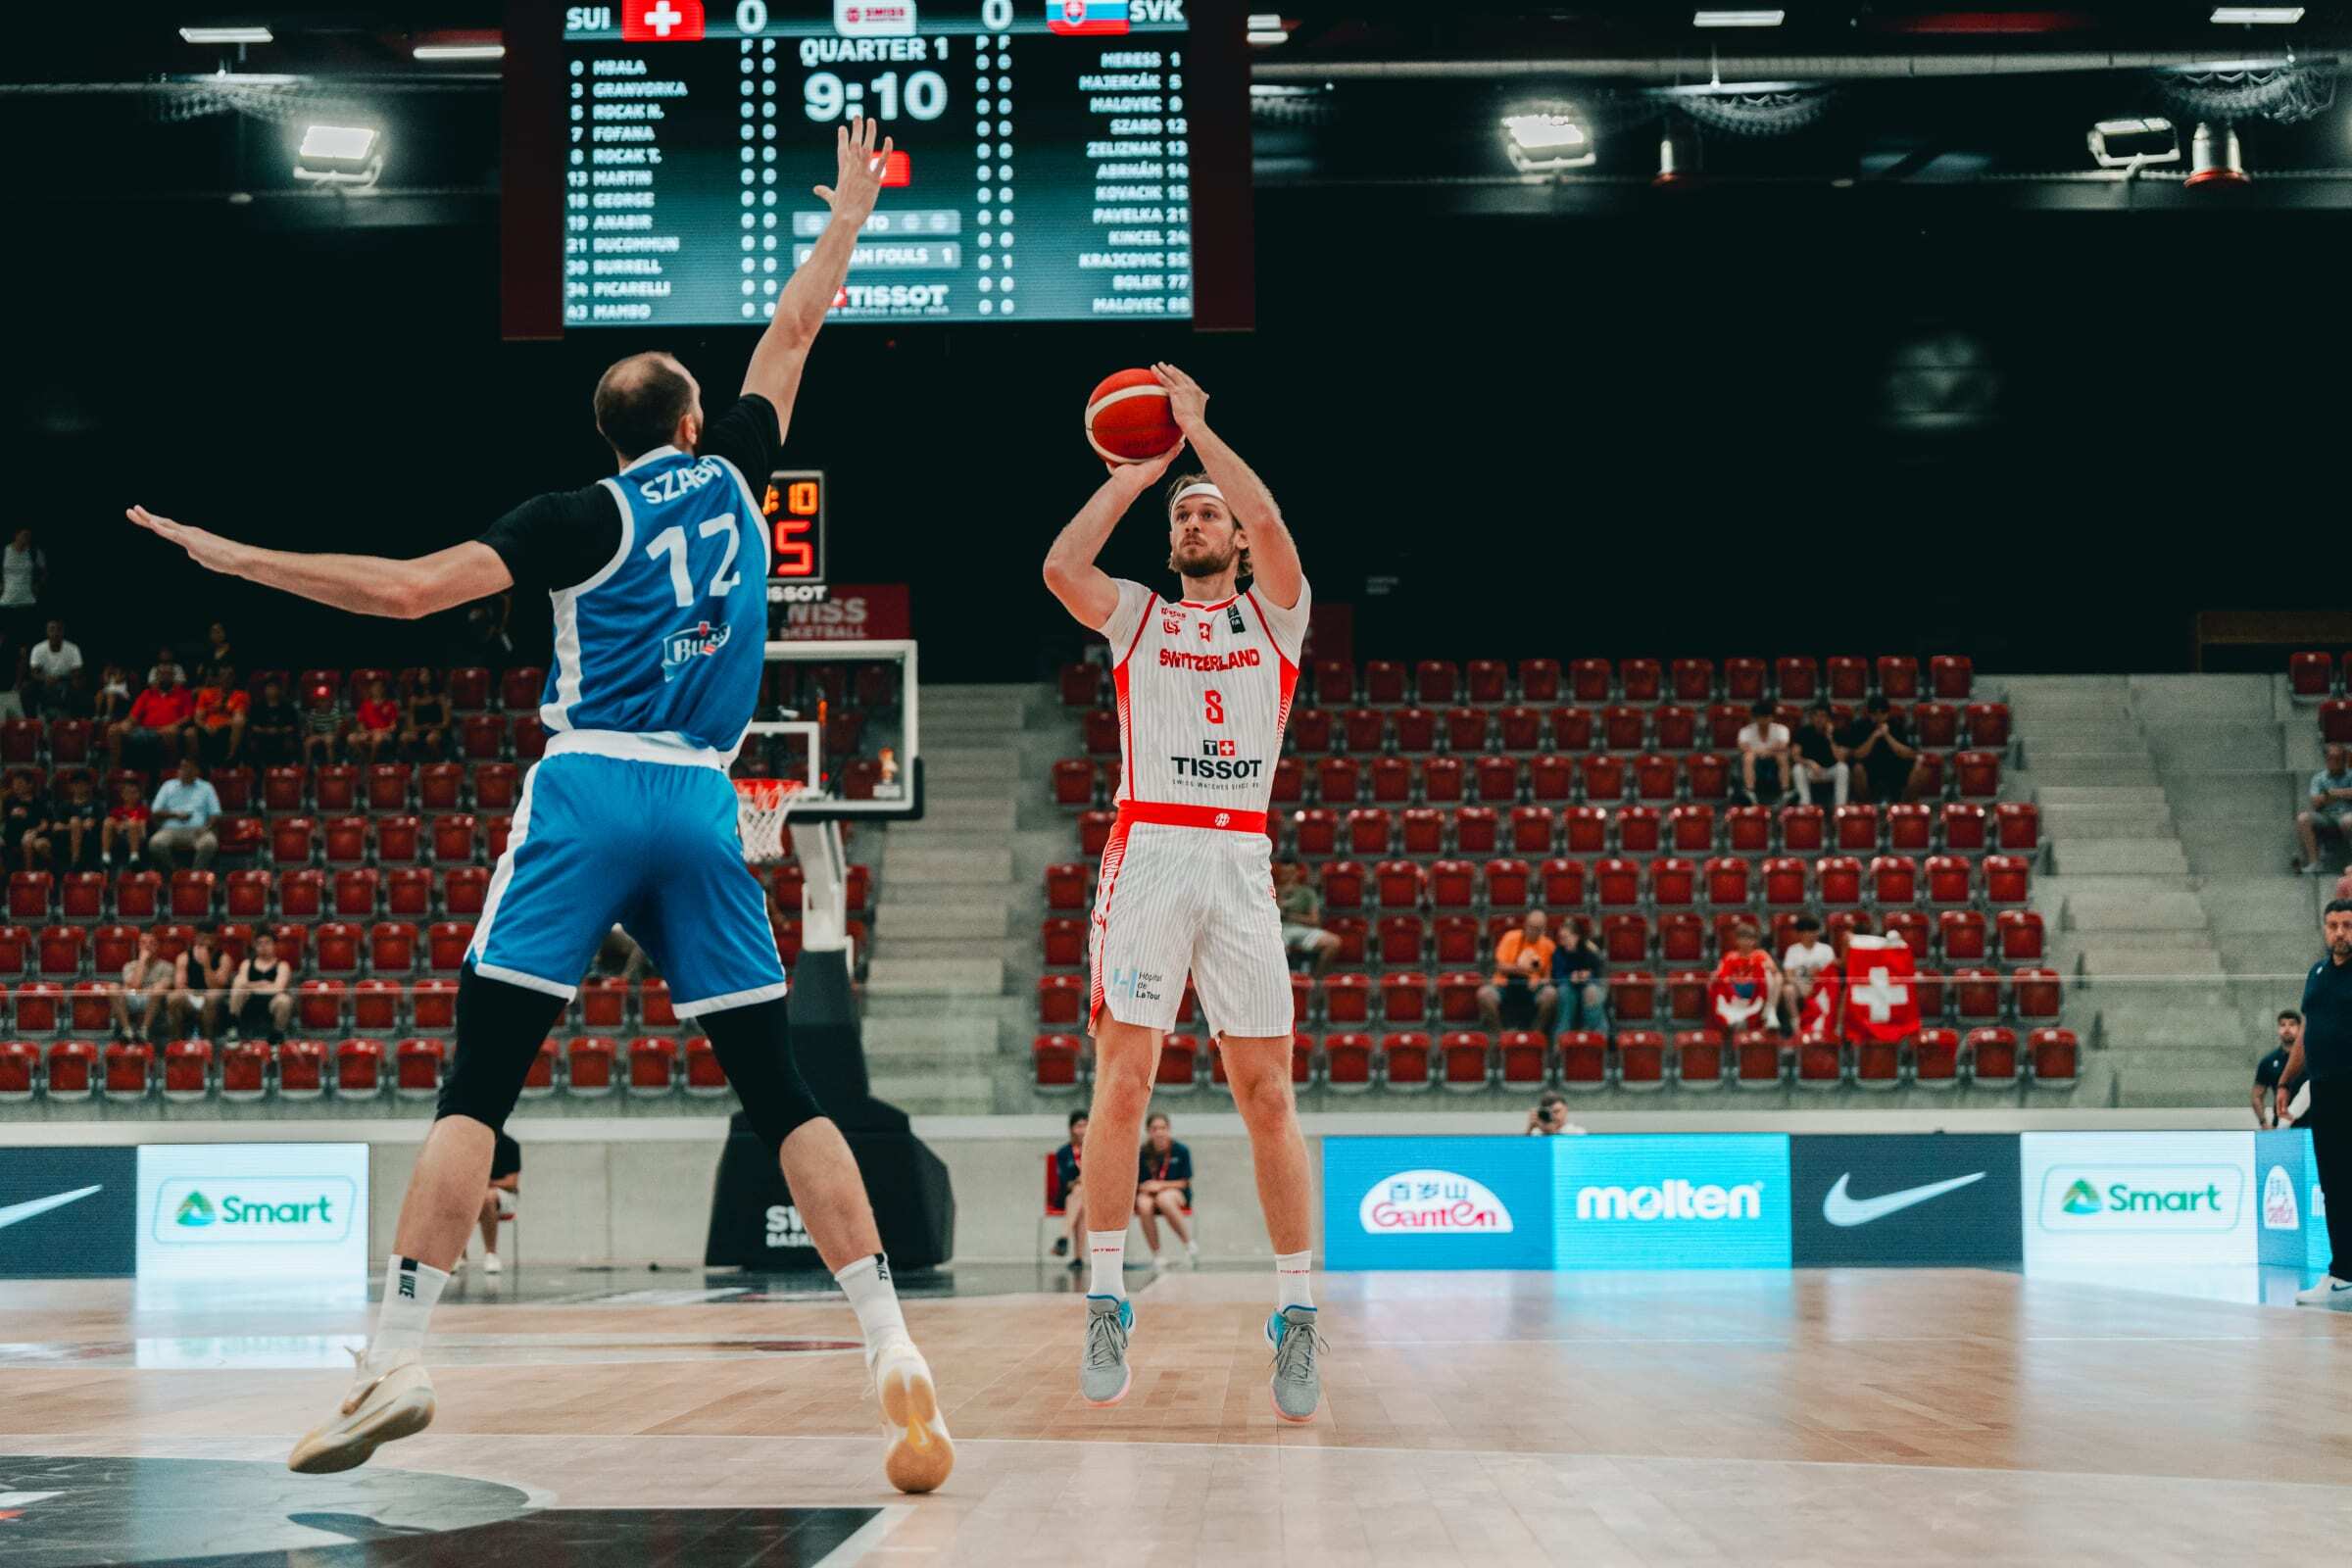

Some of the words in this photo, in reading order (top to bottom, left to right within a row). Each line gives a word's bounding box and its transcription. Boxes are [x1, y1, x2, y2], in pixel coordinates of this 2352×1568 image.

[566, 8, 610, 30] SUI
[736, 0, 767, 34] 0
[982, 0, 1013, 30] 0
[1130, 0, 1183, 24] SVK
[800, 38, 927, 67] QUARTER
[933, 36, 949, 61] 1
[1170, 51, 1181, 68] 1
[571, 82, 583, 98] 3
[805, 71, 948, 122] 9:10
[570, 126, 584, 143] 7
[1166, 118, 1188, 134] 12
[593, 171, 653, 187] MARTIN
[875, 247, 929, 265] FOULS
[942, 247, 953, 264] 1
[1167, 274, 1190, 291] 77
[846, 284, 949, 307] TISSOT
[645, 513, 741, 608] 12
[1159, 648, 1260, 672] SWITZERLAND
[1170, 756, 1262, 779] TISSOT
[221, 1195, 332, 1225] Smart
[1577, 1179, 1761, 1221] molten
[2109, 1184, 2222, 1213] Smart
[399, 1273, 416, 1299] NIKE
